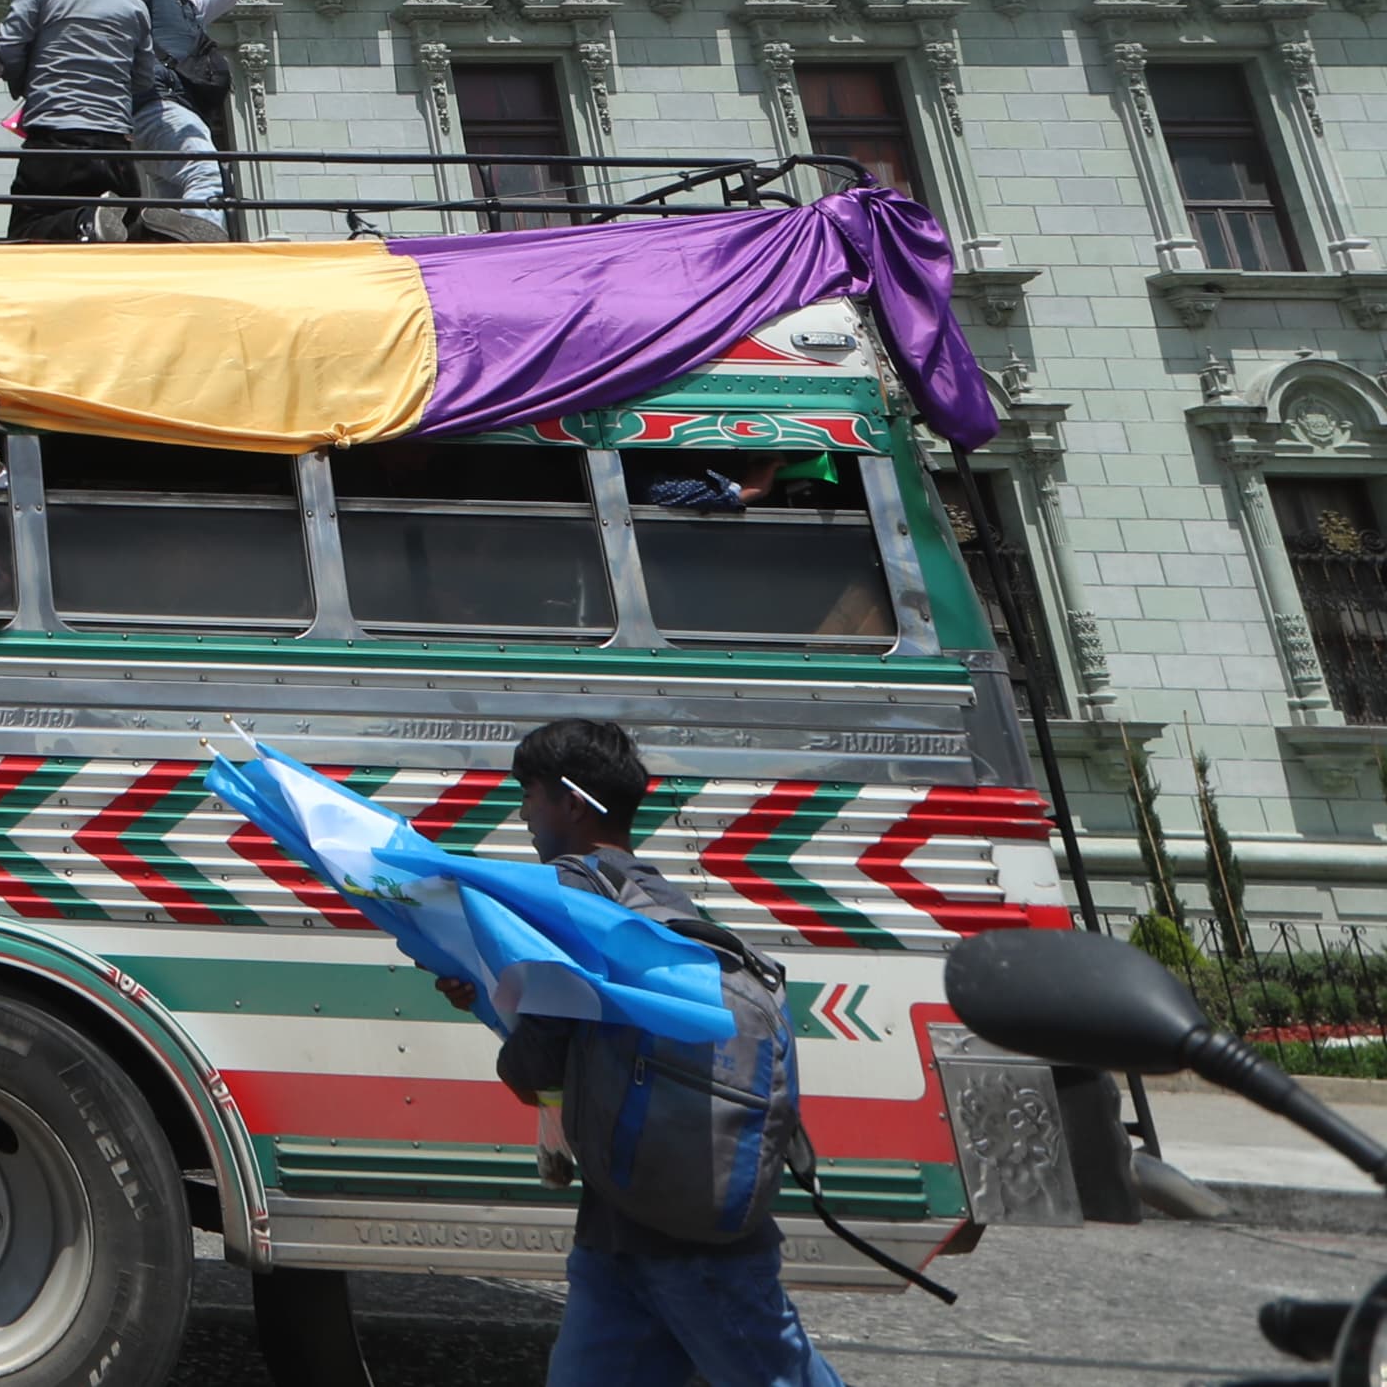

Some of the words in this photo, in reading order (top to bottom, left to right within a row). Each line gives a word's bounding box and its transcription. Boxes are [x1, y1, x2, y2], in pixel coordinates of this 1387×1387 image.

[23, 707, 76, 729] BIRD
[400, 718, 453, 740] BLUE
[459, 720, 516, 741] BIRD
[841, 732, 896, 753] BLUE
[903, 733, 966, 756] BIRD
[354, 1221, 574, 1253] TRANSPORT
